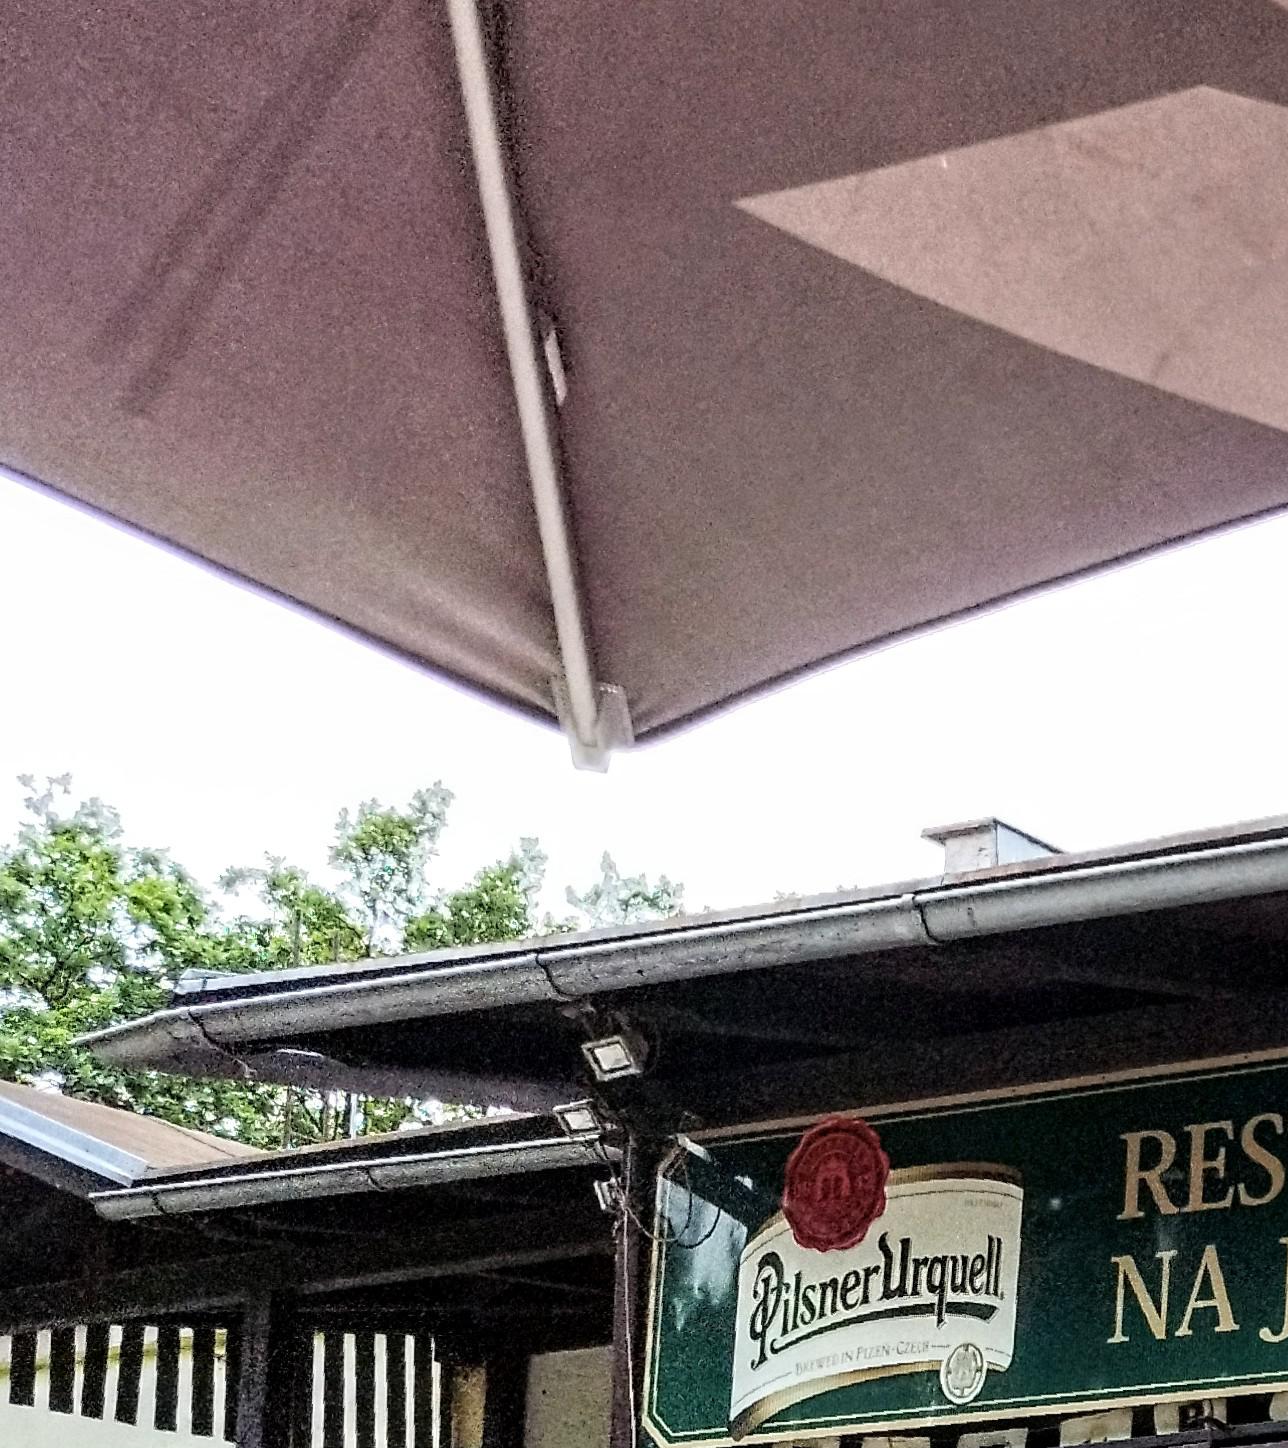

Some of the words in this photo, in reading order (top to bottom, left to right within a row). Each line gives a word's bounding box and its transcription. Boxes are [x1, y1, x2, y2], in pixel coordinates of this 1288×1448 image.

[749, 1251, 880, 1370] Pilsner
[878, 1231, 1003, 1328] Urquell
[1107, 1244, 1240, 1344] NA
[840, 1350, 853, 1365] IN
